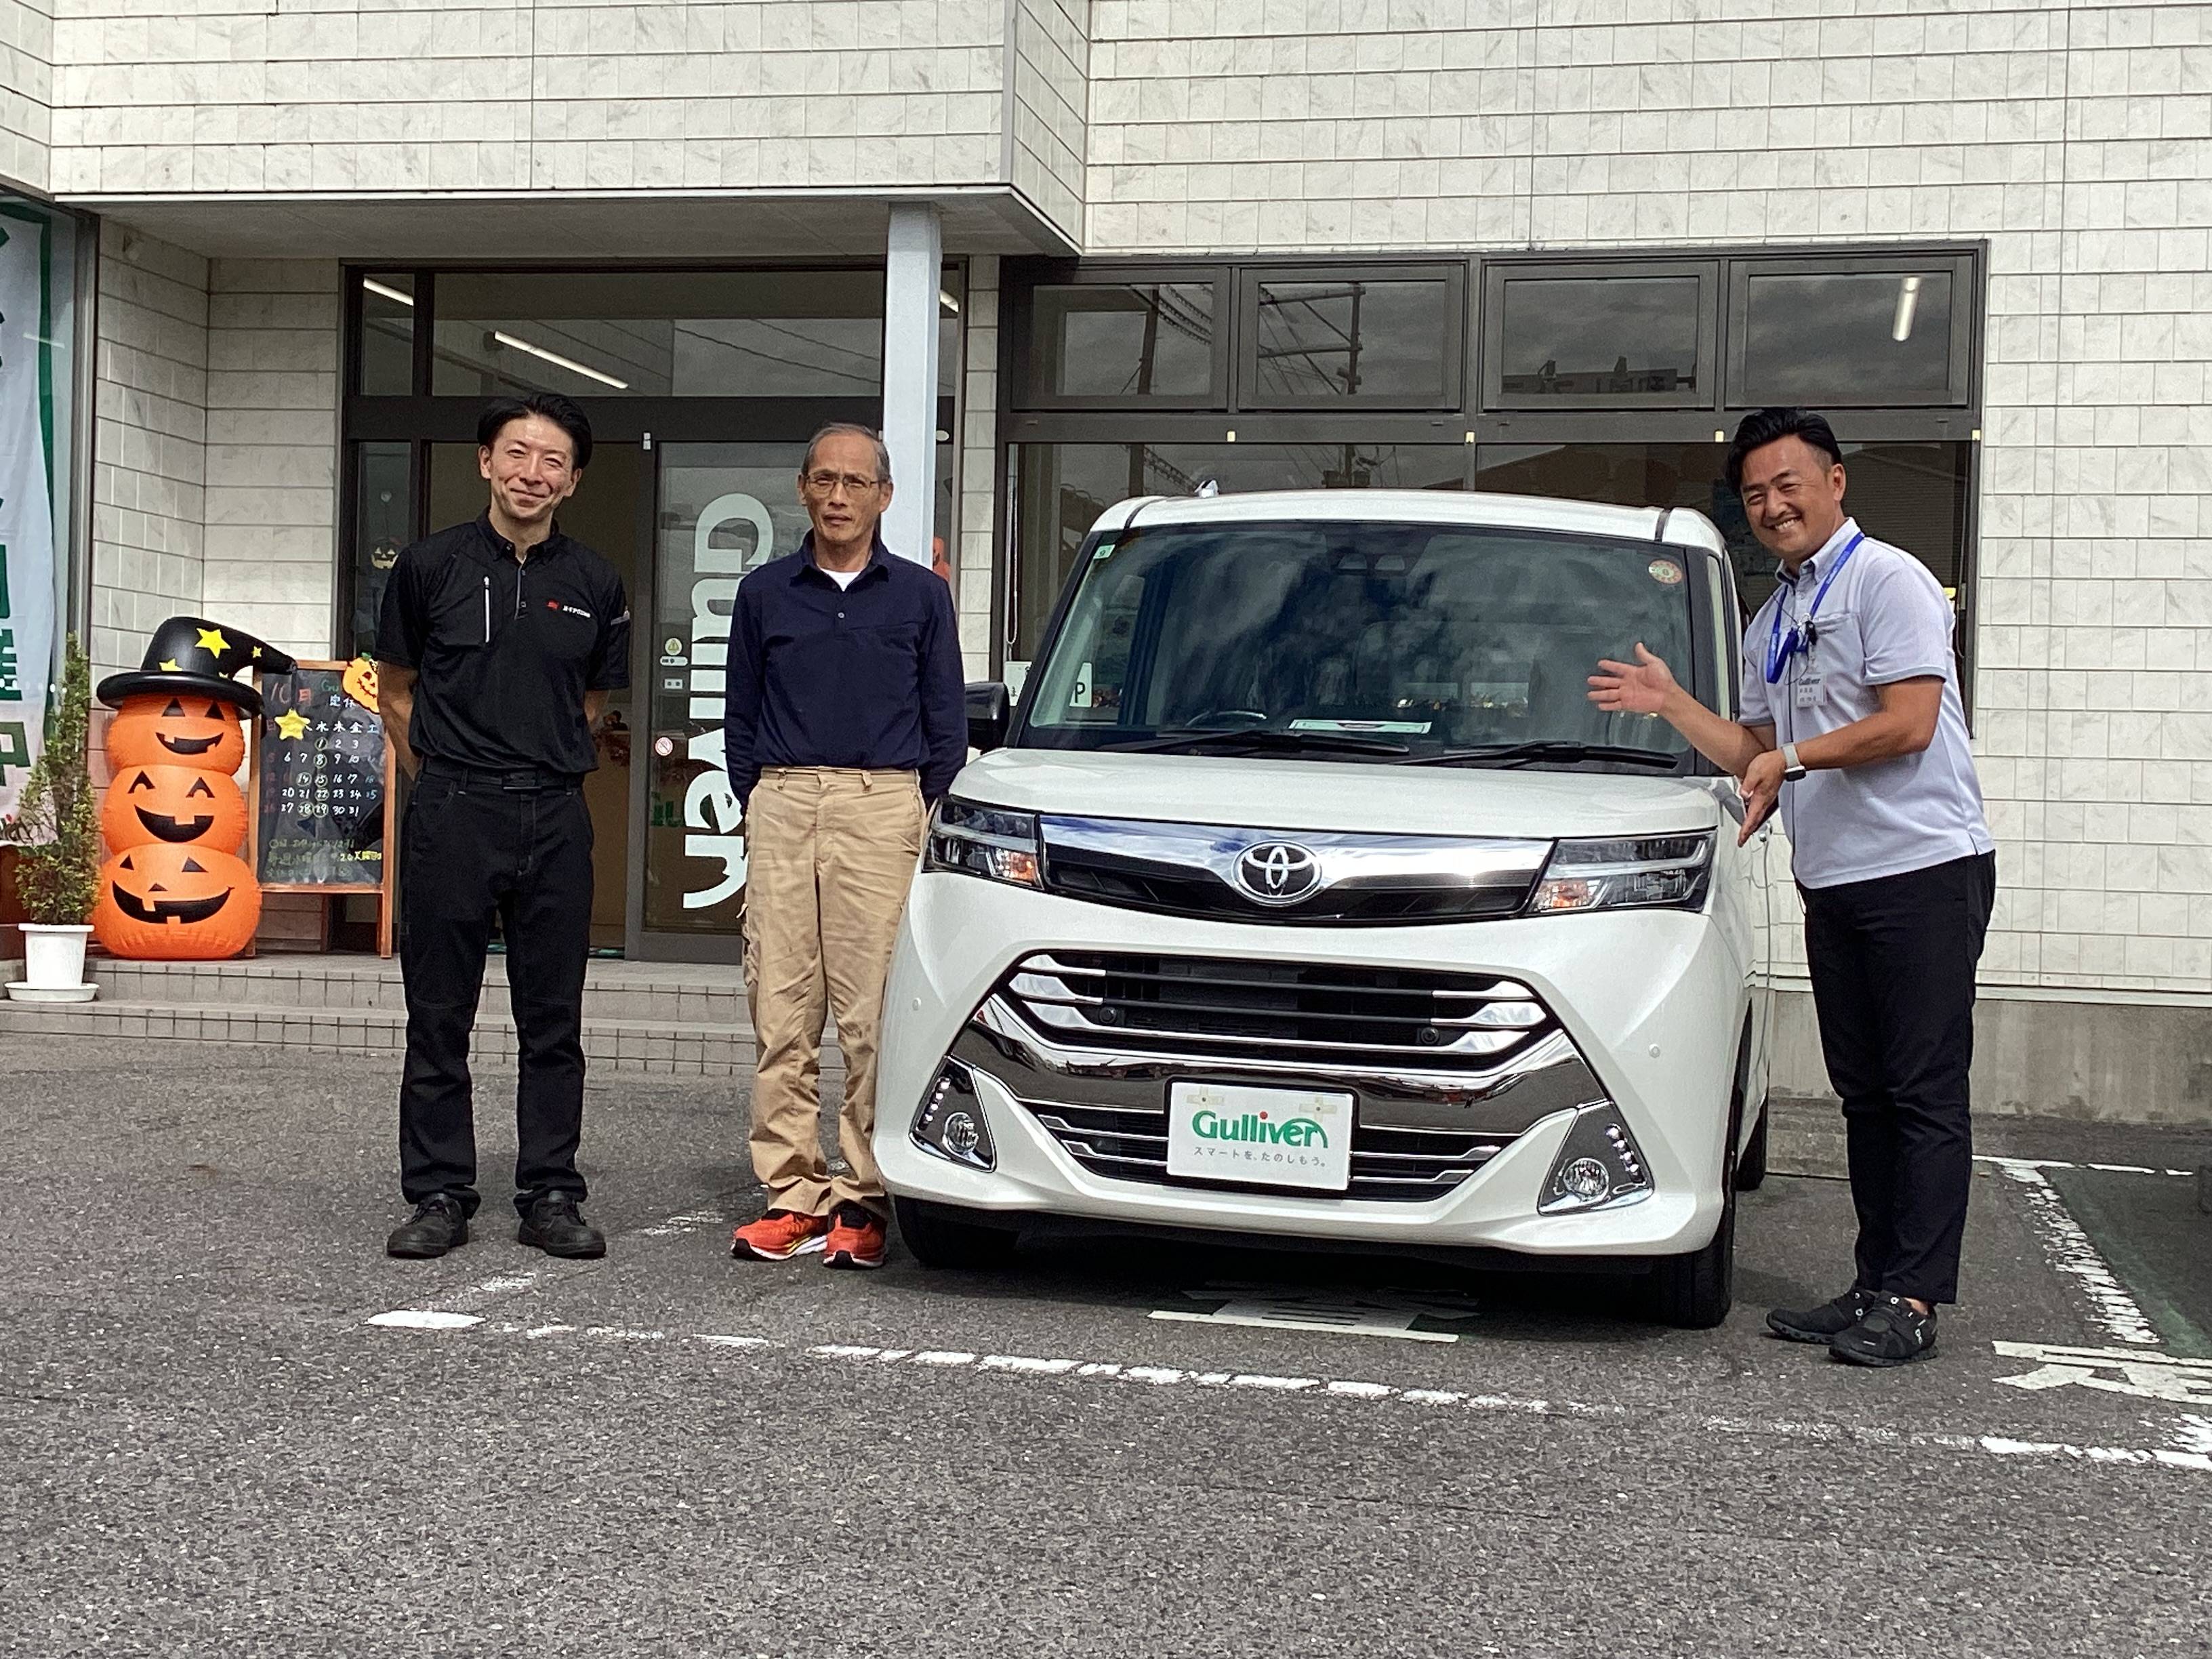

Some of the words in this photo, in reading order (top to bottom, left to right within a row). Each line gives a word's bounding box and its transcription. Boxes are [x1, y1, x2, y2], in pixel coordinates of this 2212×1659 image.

[349, 721, 363, 733] 金
[335, 739, 342, 748] 2
[352, 739, 359, 749] 3
[284, 752, 291, 762] 6
[300, 752, 308, 763] 7
[334, 753, 341, 764] 9
[348, 754, 359, 763] 10
[282, 787, 295, 798] 20
[299, 788, 310, 799] 21
[332, 806, 345, 816] 30
[1191, 1110, 1328, 1149] Gulliver
[1193, 1146, 1326, 1167] スマートを、たのしもう。
